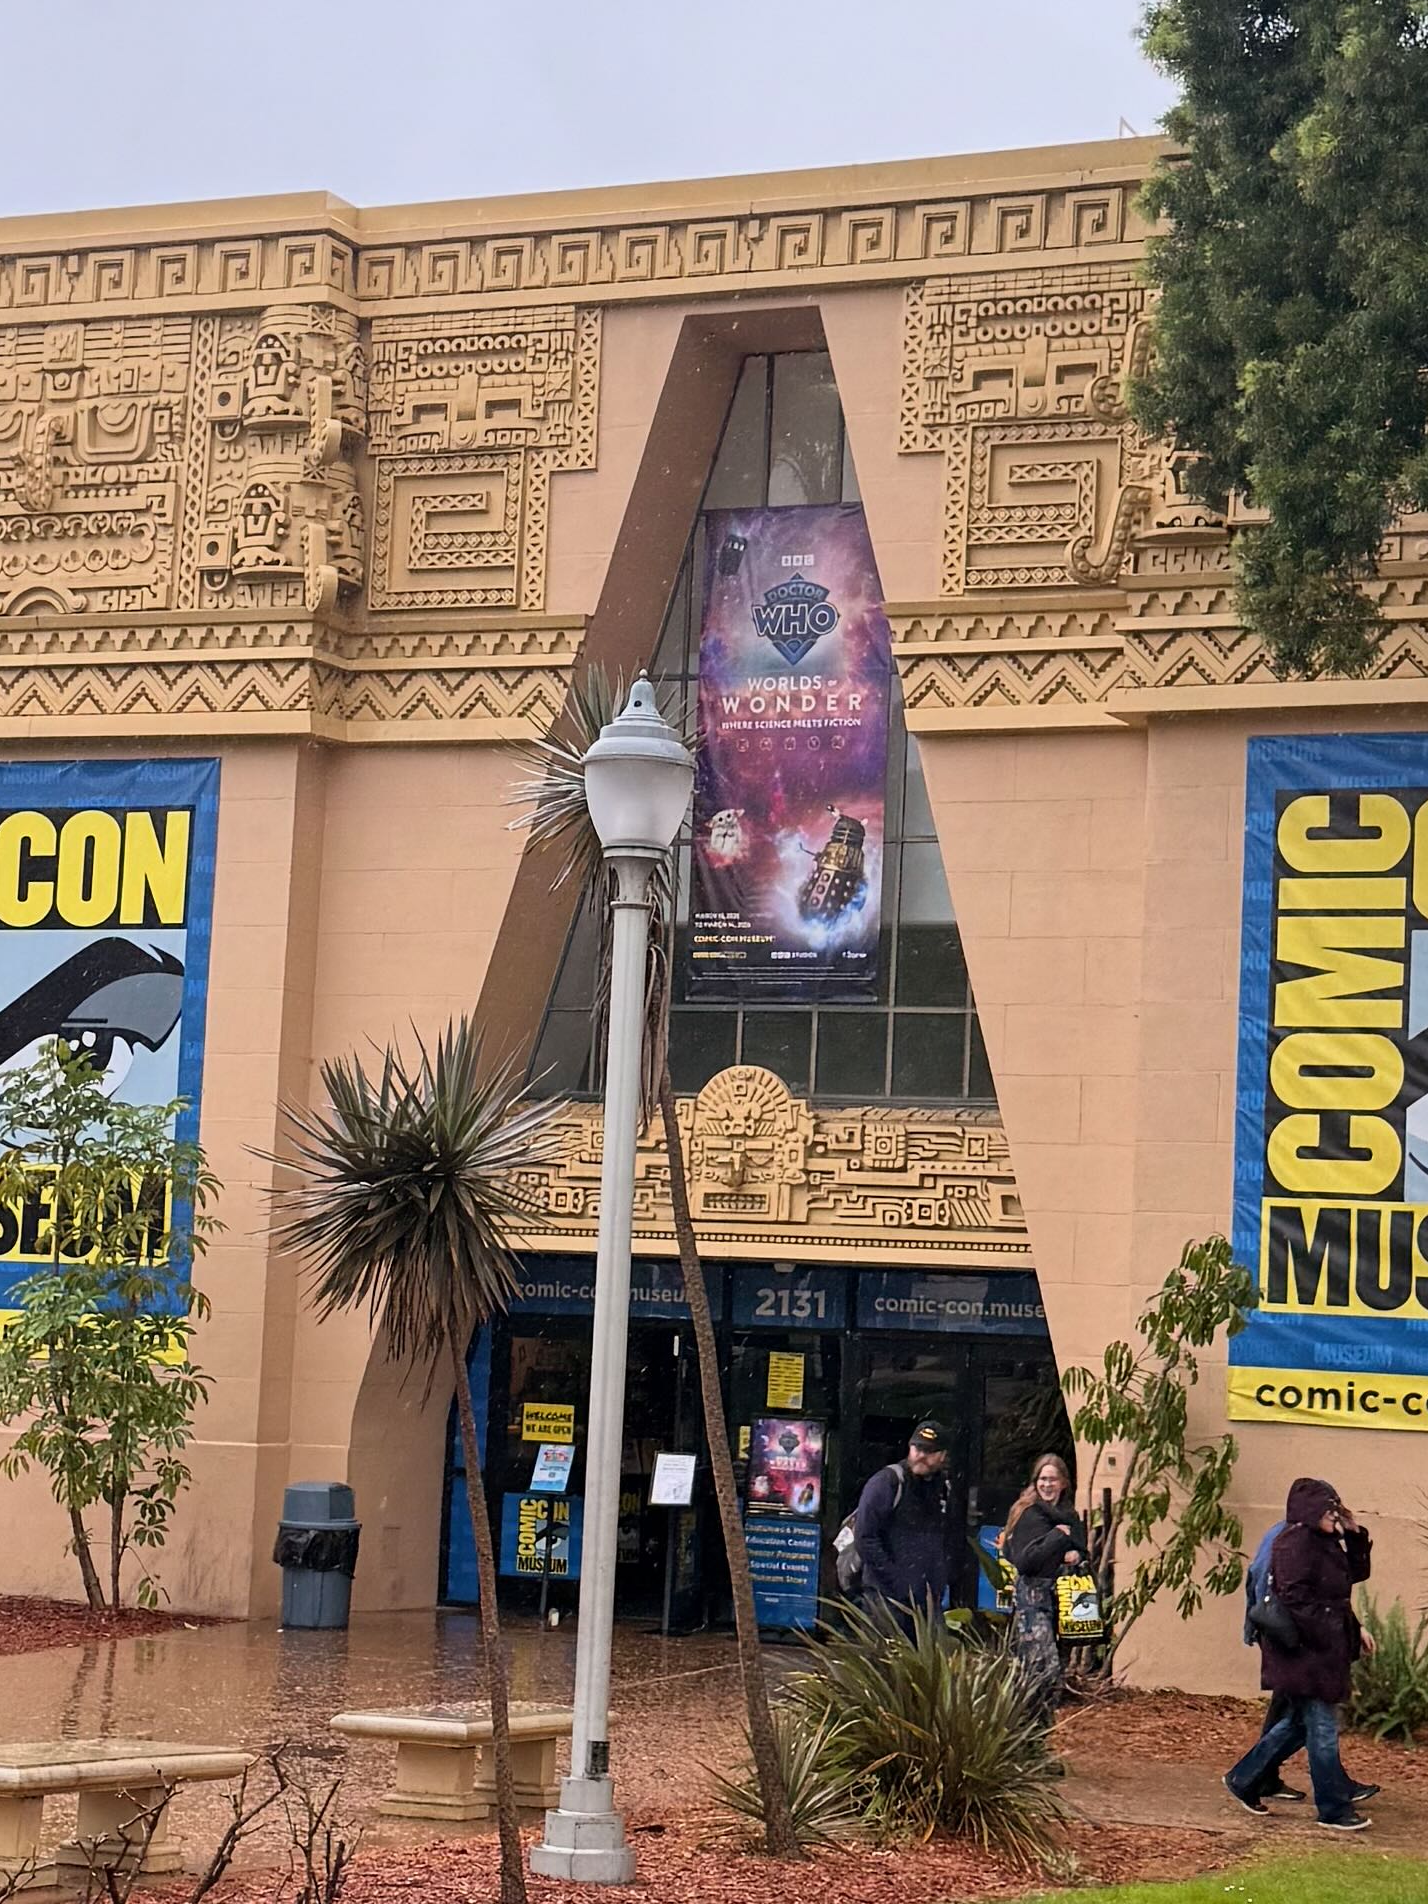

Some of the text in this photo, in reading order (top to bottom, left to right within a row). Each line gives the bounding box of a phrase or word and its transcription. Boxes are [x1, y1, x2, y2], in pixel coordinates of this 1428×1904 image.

[767, 583, 823, 603] DOCTOR
[752, 602, 839, 636] WHO
[747, 675, 822, 691] WORLDS
[722, 694, 862, 714] WONDER
[722, 718, 861, 730] WHERE SCIENCE MEETS FICTION
[1267, 793, 1411, 1196] COMIC
[755, 1288, 826, 1318] 2131
[525, 1410, 572, 1422] WELCOME
[518, 1499, 538, 1556] COMIC
[517, 1556, 568, 1574] MUSUM
